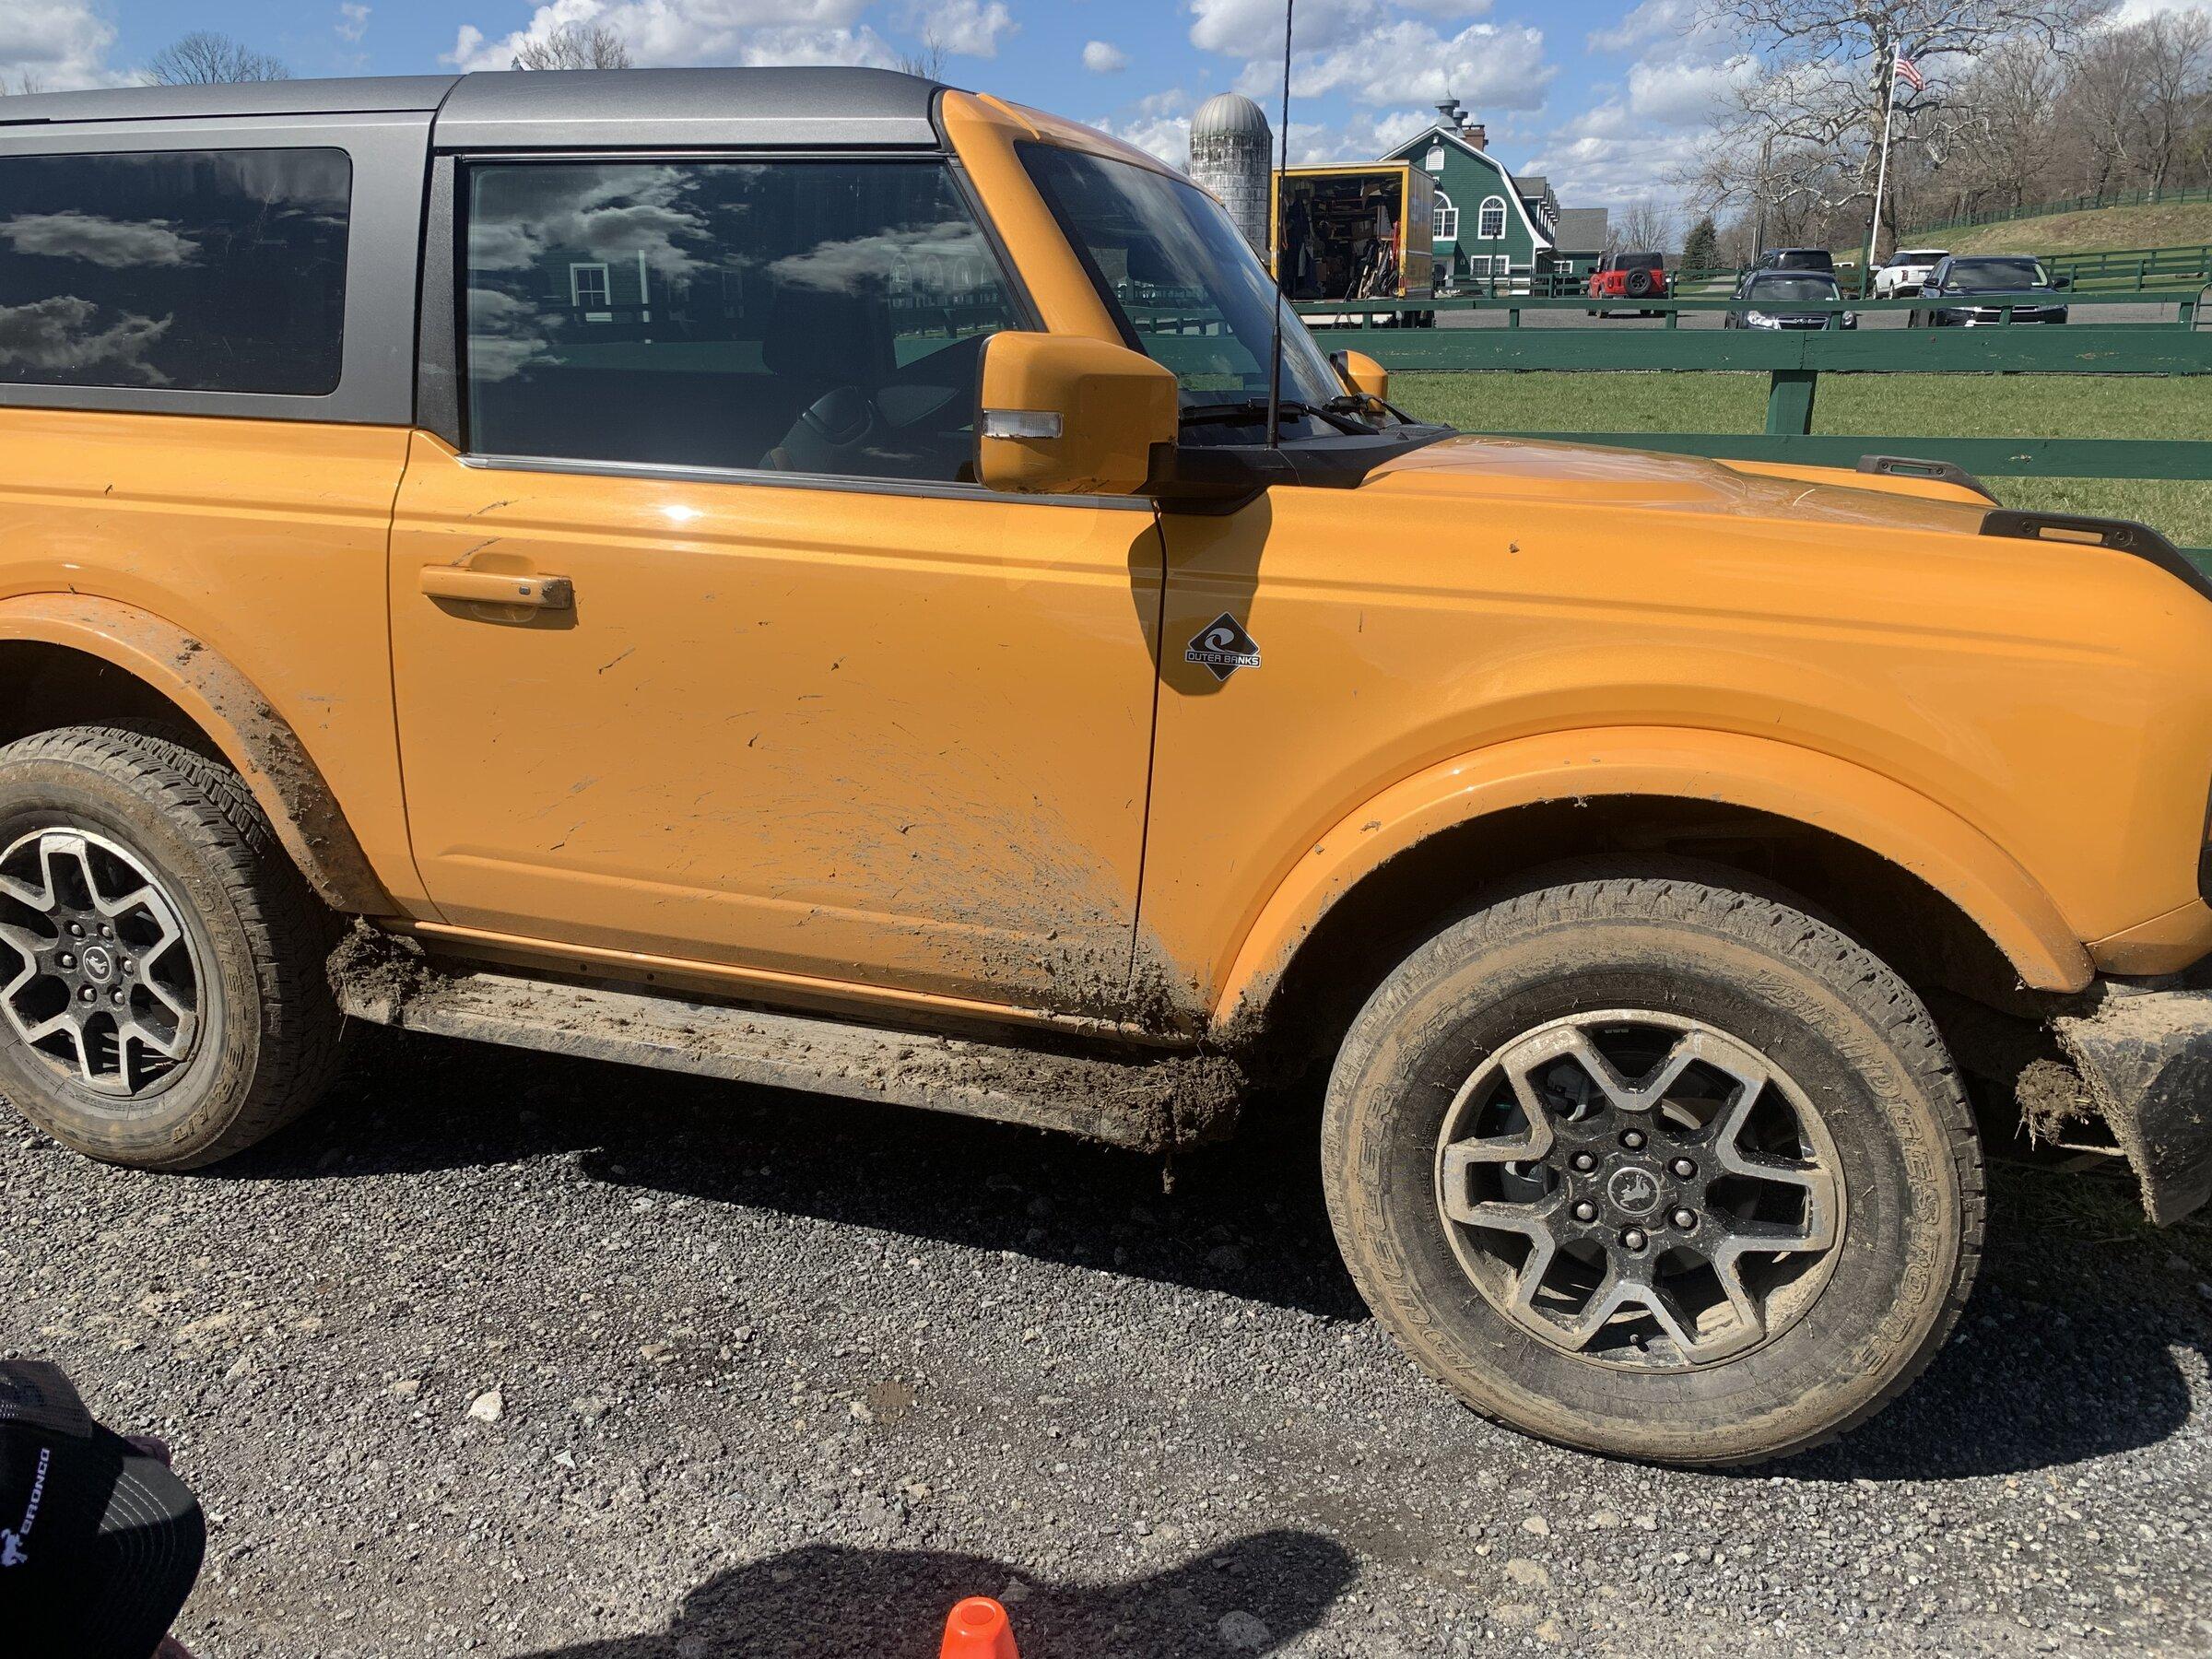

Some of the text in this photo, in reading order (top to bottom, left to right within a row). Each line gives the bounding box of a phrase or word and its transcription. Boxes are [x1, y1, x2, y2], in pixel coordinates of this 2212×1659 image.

[1188, 652, 1259, 665] OUTER BANKS
[1359, 1082, 1477, 1377] DUELER
[20, 1448, 50, 1535] BRONCO
